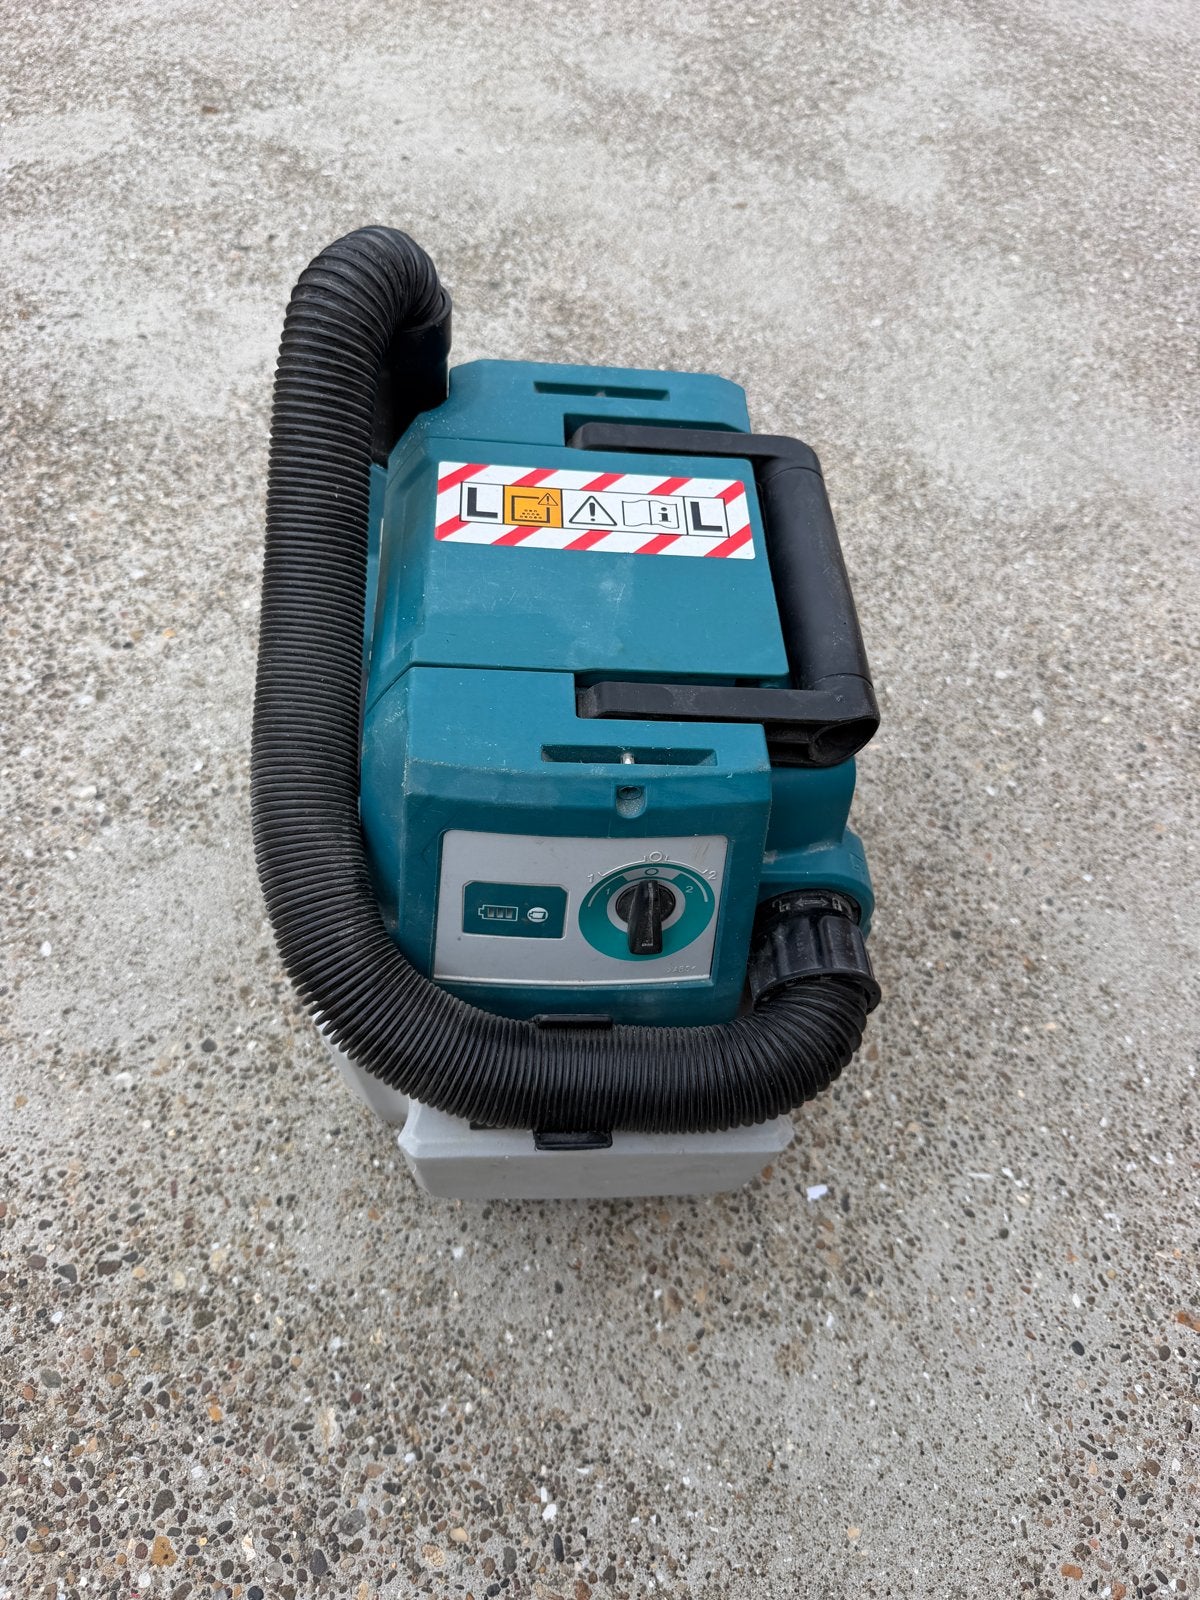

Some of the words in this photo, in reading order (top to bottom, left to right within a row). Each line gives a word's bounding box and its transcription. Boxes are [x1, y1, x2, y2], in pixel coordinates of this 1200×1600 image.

[467, 487, 498, 518] L
[690, 501, 723, 532] L
[587, 873, 595, 883] 1
[707, 870, 717, 881] 2
[685, 885, 694, 893] 2
